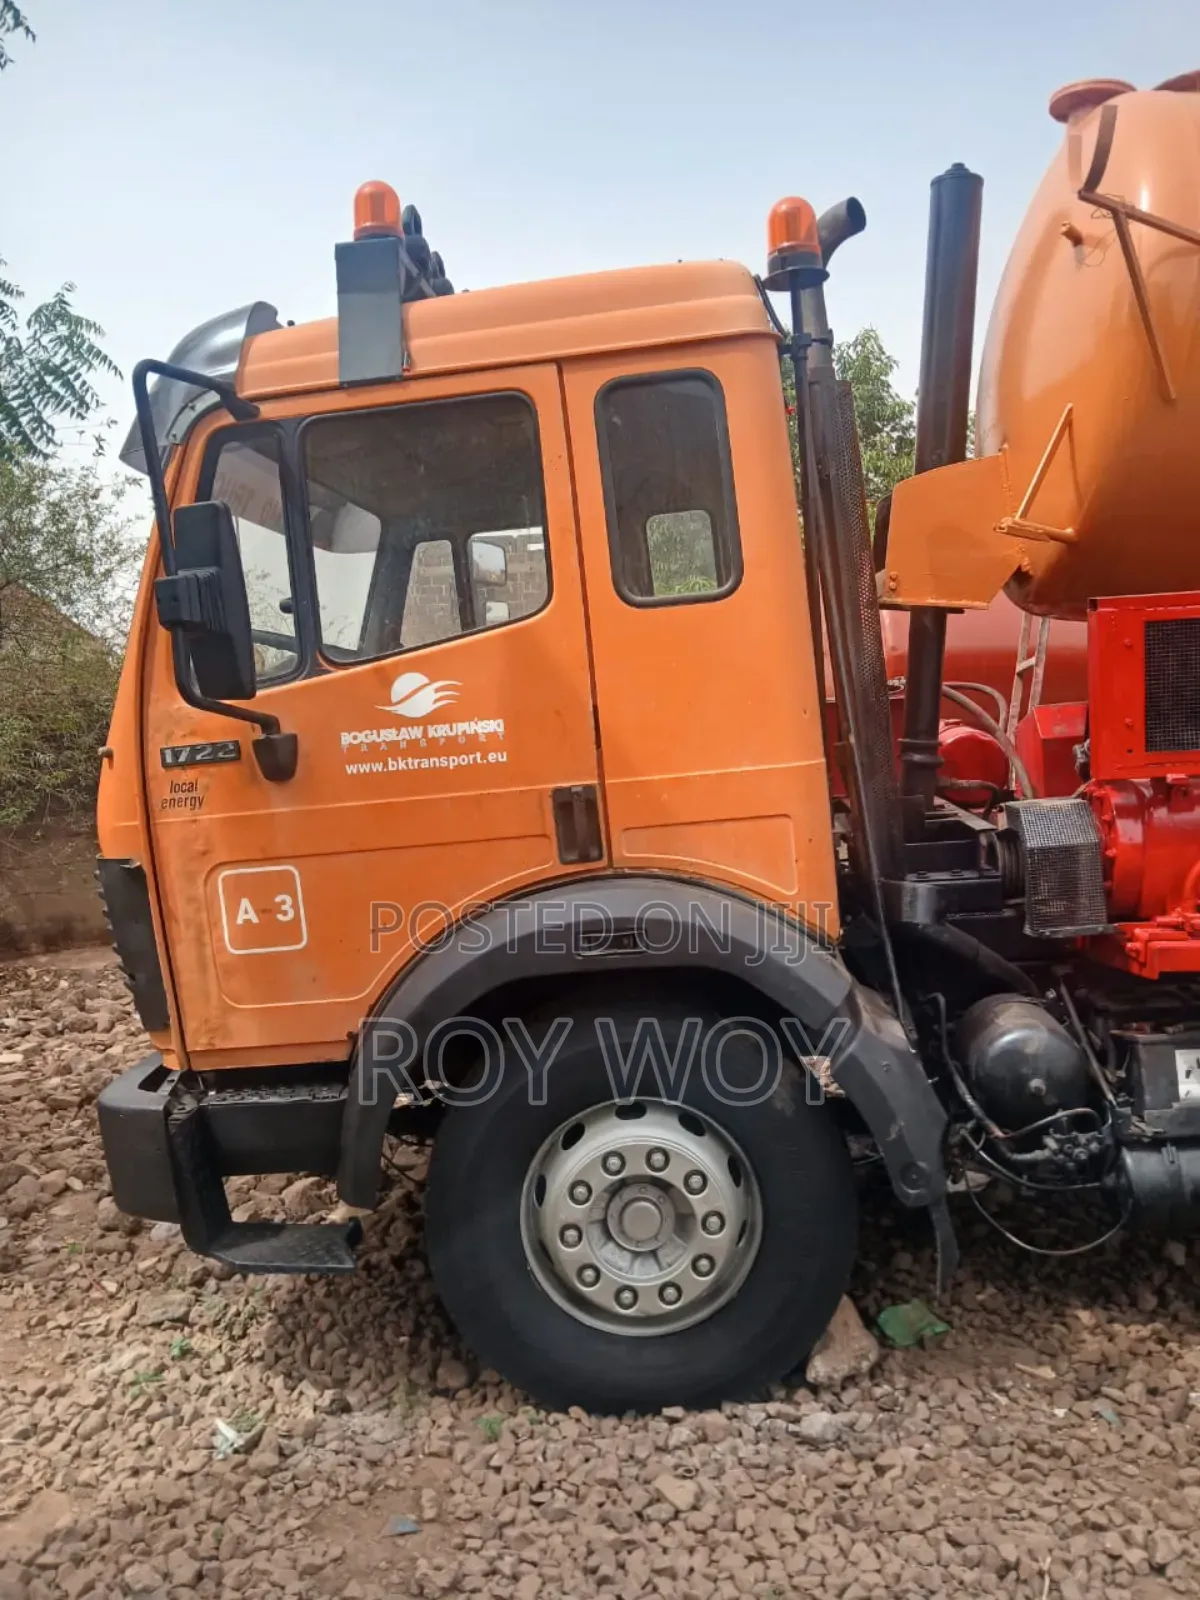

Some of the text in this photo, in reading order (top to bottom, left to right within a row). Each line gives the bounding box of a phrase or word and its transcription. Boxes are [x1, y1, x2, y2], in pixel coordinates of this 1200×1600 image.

[345, 751, 507, 775] www.bktransport.eu
[169, 779, 198, 794] local
[161, 796, 205, 811] energy
